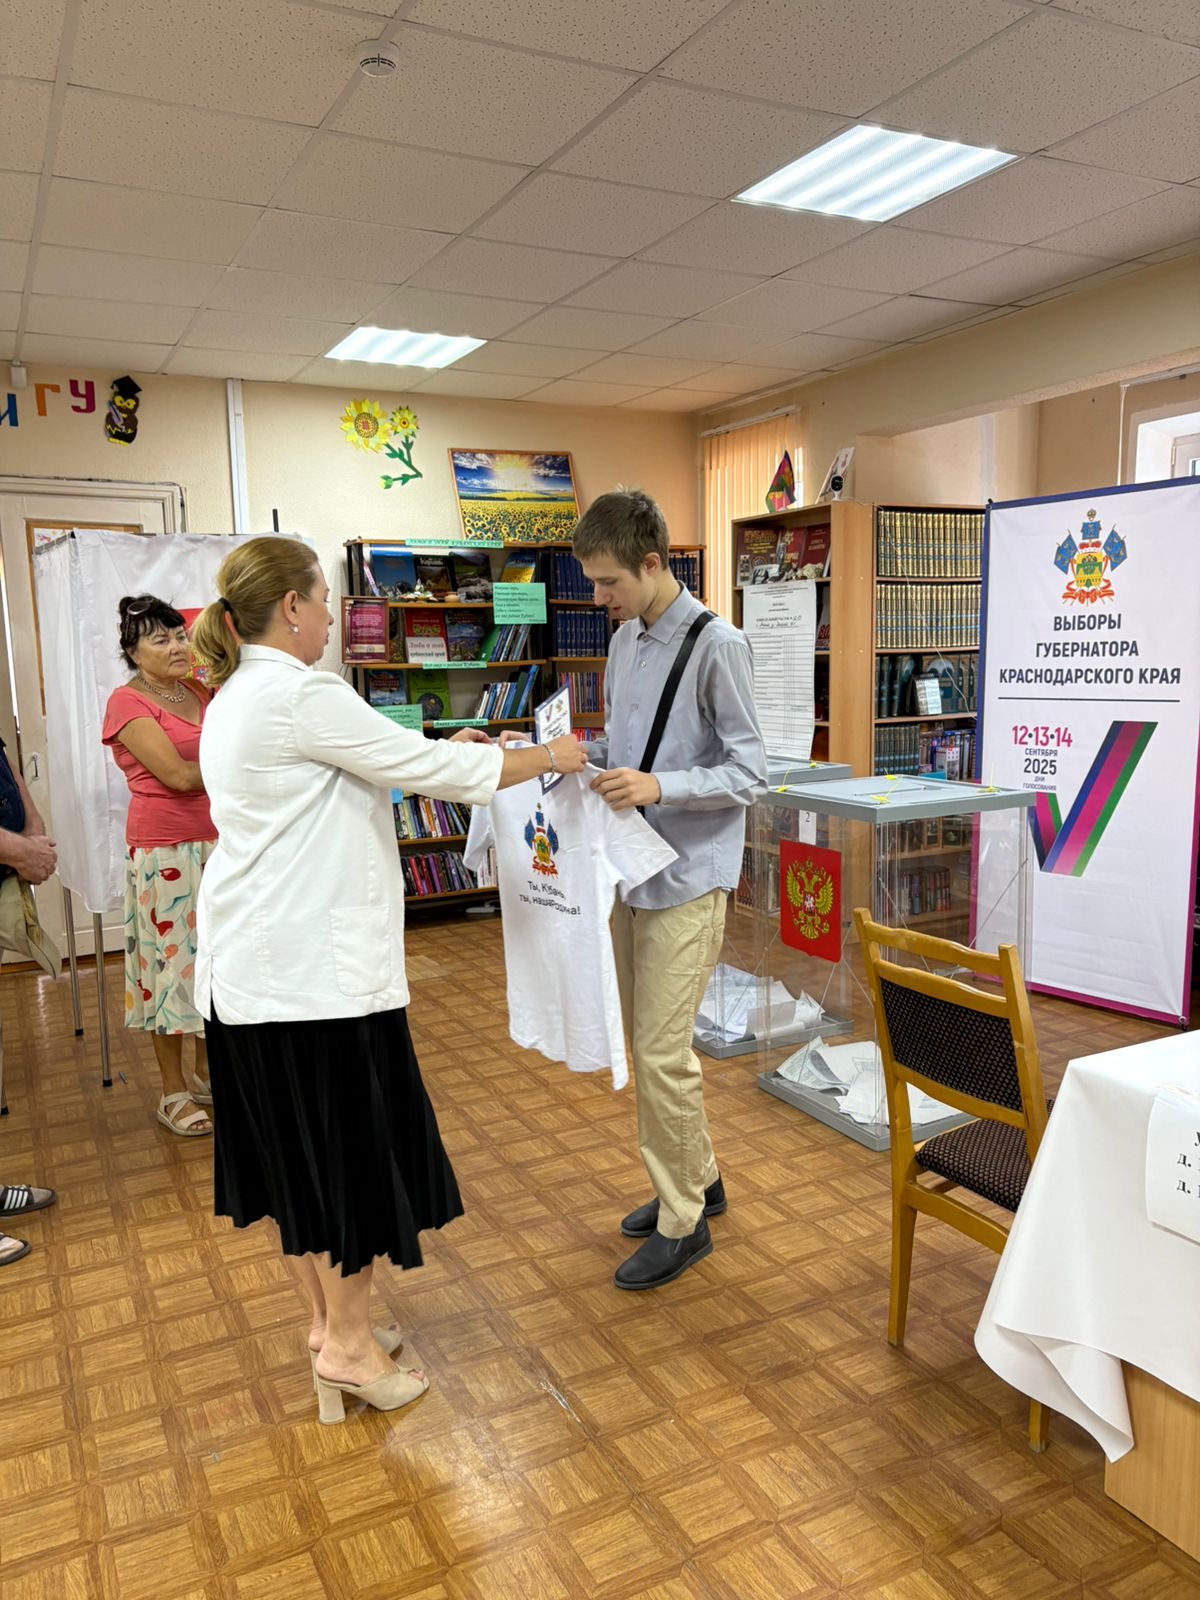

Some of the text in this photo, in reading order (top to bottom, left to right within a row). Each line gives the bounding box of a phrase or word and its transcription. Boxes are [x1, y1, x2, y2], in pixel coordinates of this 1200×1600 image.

[1053, 613, 1122, 631] ВЫБОРЫ
[1036, 640, 1139, 658] ГУБЕРНАТОРА
[999, 667, 1181, 686] КРАСНОДАРСКОГО КРАЯ
[1024, 748, 1058, 756] СЕНТЯБРЯ
[1024, 758, 1057, 775] 2025
[805, 811, 811, 823] 2
